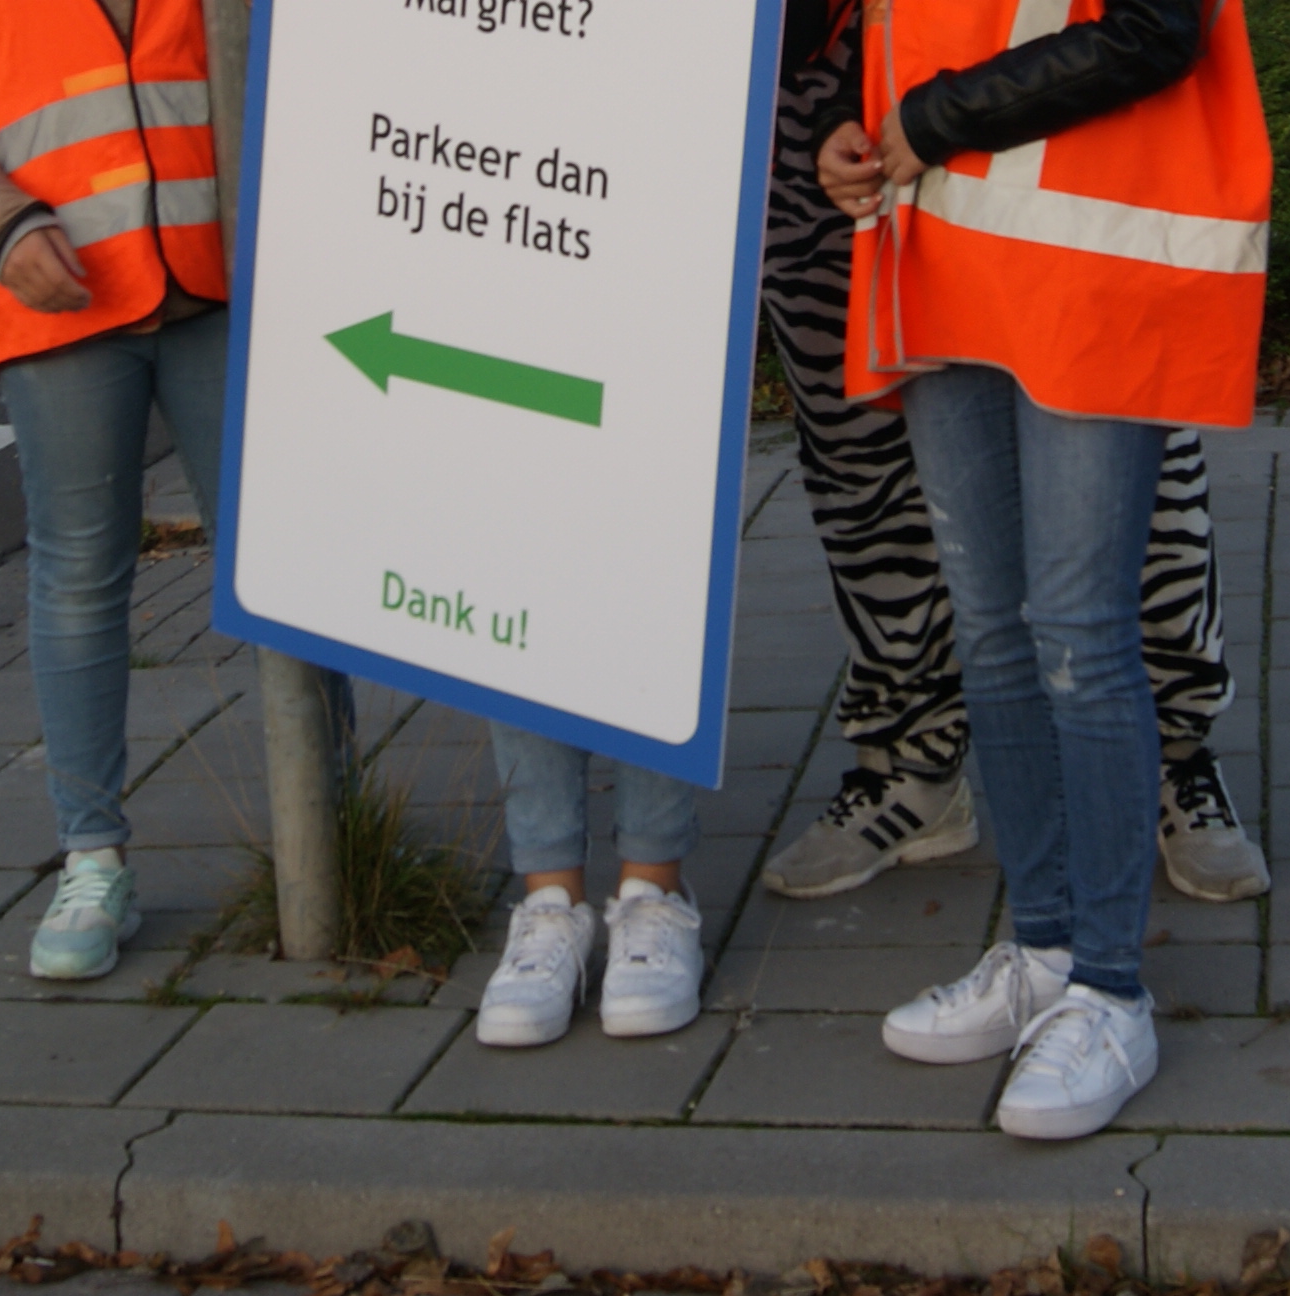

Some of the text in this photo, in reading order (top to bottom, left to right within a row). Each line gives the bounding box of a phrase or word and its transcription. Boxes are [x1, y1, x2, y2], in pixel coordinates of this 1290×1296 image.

[370, 113, 609, 199] Parkeer dan
[377, 175, 592, 260] bij de flats
[381, 570, 529, 650] Dank u!
